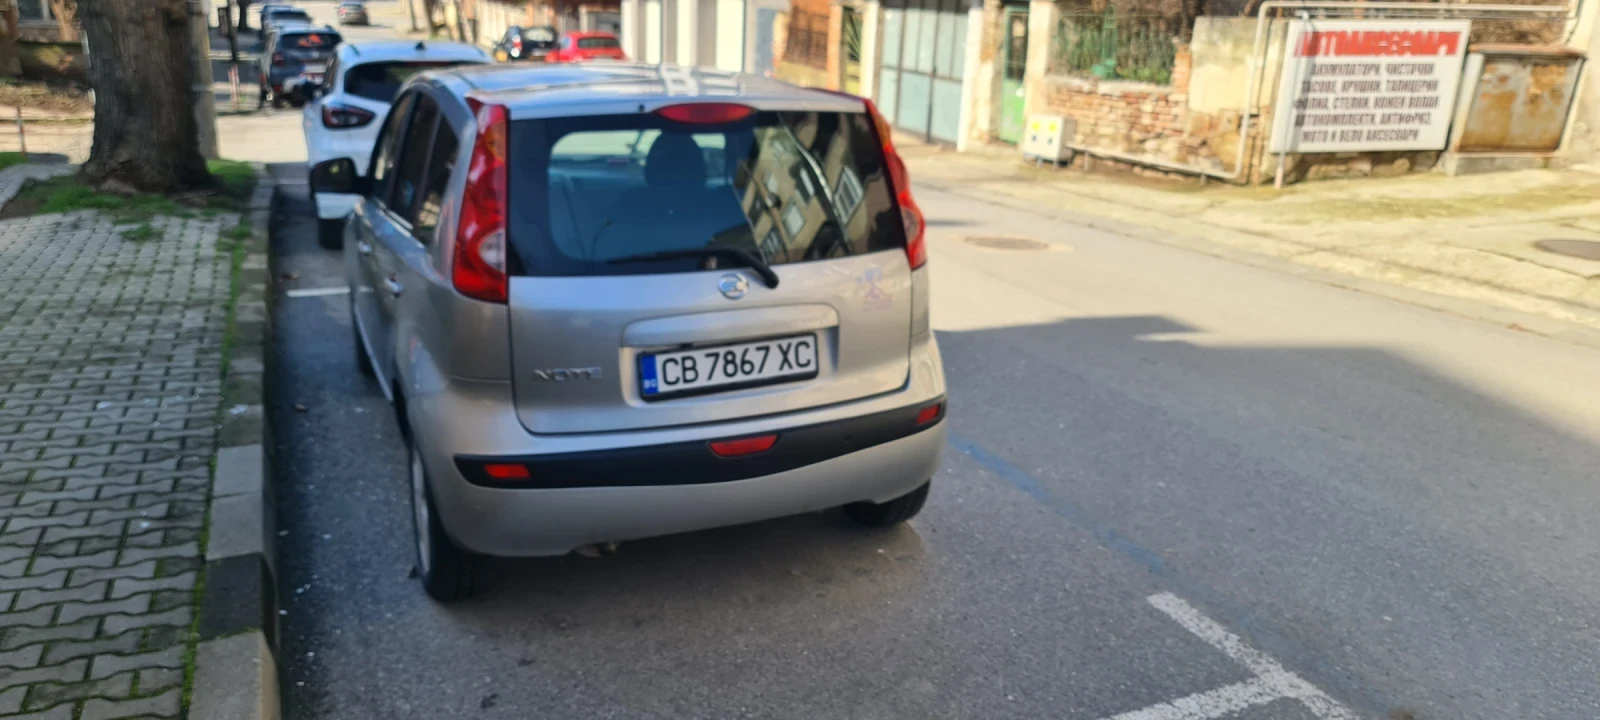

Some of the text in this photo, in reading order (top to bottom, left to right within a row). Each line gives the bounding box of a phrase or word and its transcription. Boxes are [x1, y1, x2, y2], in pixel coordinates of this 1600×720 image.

[533, 366, 602, 382] NOTE
[662, 341, 812, 386] CB 7867 XC
